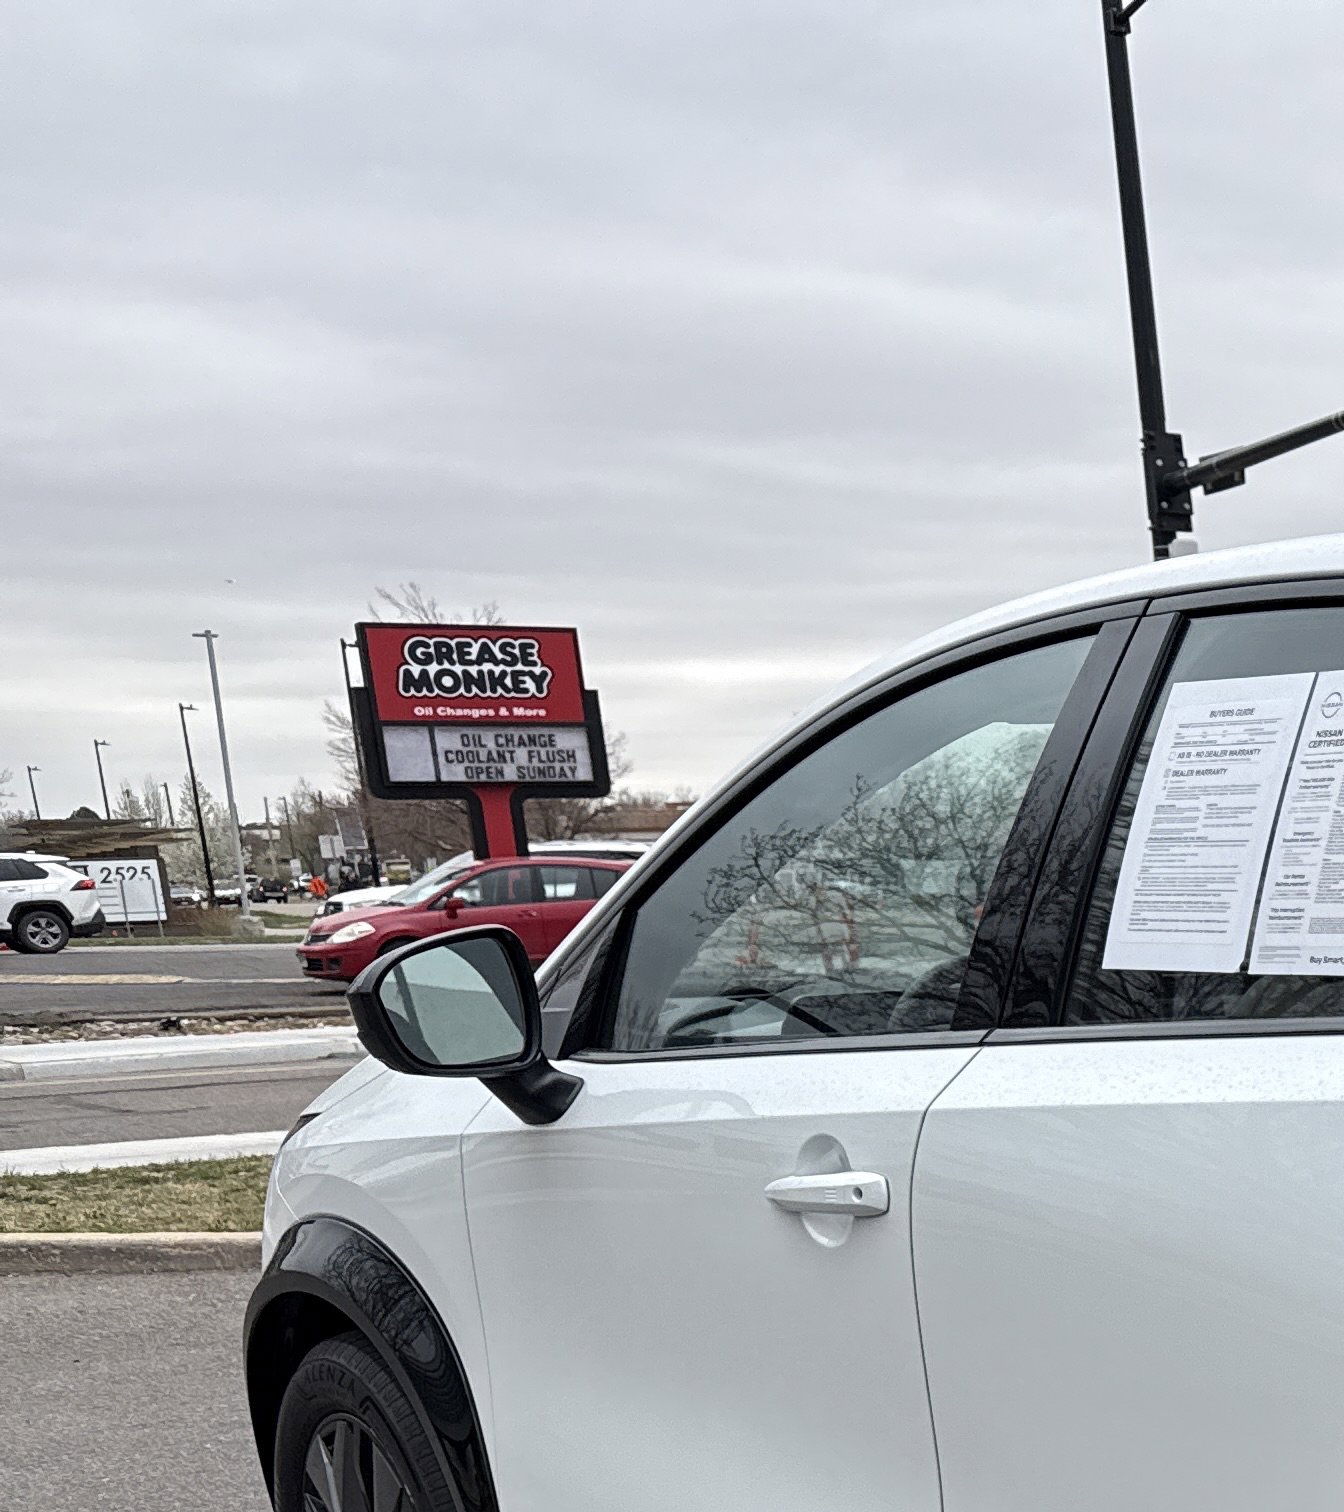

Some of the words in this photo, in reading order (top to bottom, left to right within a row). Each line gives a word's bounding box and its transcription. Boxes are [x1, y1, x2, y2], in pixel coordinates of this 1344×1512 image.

[407, 640, 537, 667] GREASE
[402, 668, 549, 695] MONKEY
[413, 705, 433, 717] Oil
[436, 706, 495, 718] Changes
[500, 706, 510, 717] &
[513, 706, 547, 717] More
[1235, 708, 1256, 717] GUIDE
[1316, 729, 1344, 737] NISSAN
[461, 734, 486, 748] OIL
[495, 734, 557, 748] CHANGE
[444, 749, 515, 765] COOLANT
[528, 750, 577, 764] FLUSH
[1228, 748, 1262, 757] WARRANTY
[464, 766, 504, 780] OPEN
[516, 765, 578, 780] SUNDAY
[1195, 768, 1228, 777] WARRANTY
[1310, 956, 1322, 966] Buy
[1323, 956, 1344, 966] Smart,
